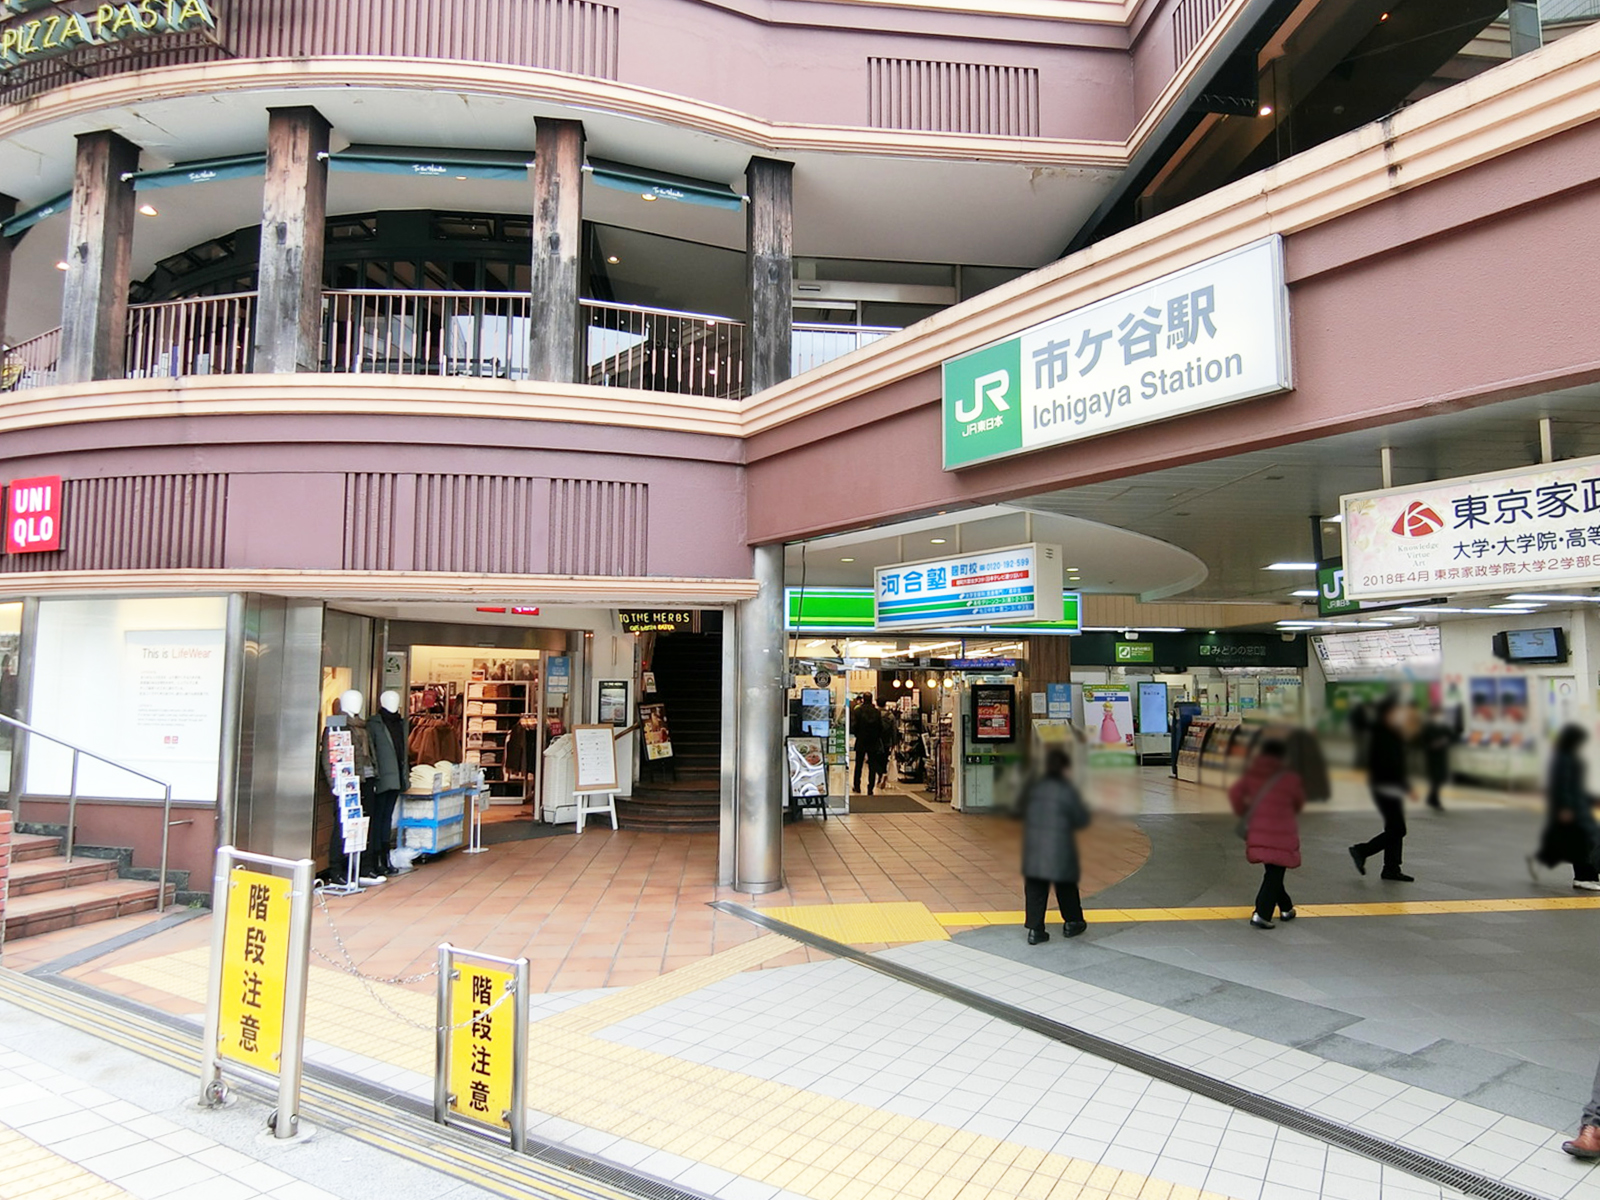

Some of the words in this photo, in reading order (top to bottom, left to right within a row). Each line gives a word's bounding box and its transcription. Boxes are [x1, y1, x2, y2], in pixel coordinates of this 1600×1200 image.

[3, 14, 85, 58] PIZZA
[96, 0, 210, 35] PASTA
[1032, 284, 1217, 390] 市ケ谷駅
[955, 369, 1011, 424] JR
[1033, 384, 1132, 430] Ichigaya
[1140, 353, 1243, 401] Station
[962, 414, 1004, 438] JR東日本
[15, 486, 52, 514] UNI
[13, 515, 54, 547] QLO
[1397, 542, 1439, 552] Knowledge
[1406, 551, 1430, 559] Virtue
[1363, 569, 1430, 587] 2018年4月
[1412, 559, 1426, 568] Art
[881, 566, 947, 597] 河合塾
[619, 613, 629, 623] TO
[631, 612, 650, 623] THE
[653, 612, 690, 623] HERBS
[143, 648, 159, 659] This
[162, 648, 169, 659] is
[172, 648, 212, 659] LifeWear
[238, 884, 270, 1053] 階段注意
[469, 975, 493, 1113] 階段注意
